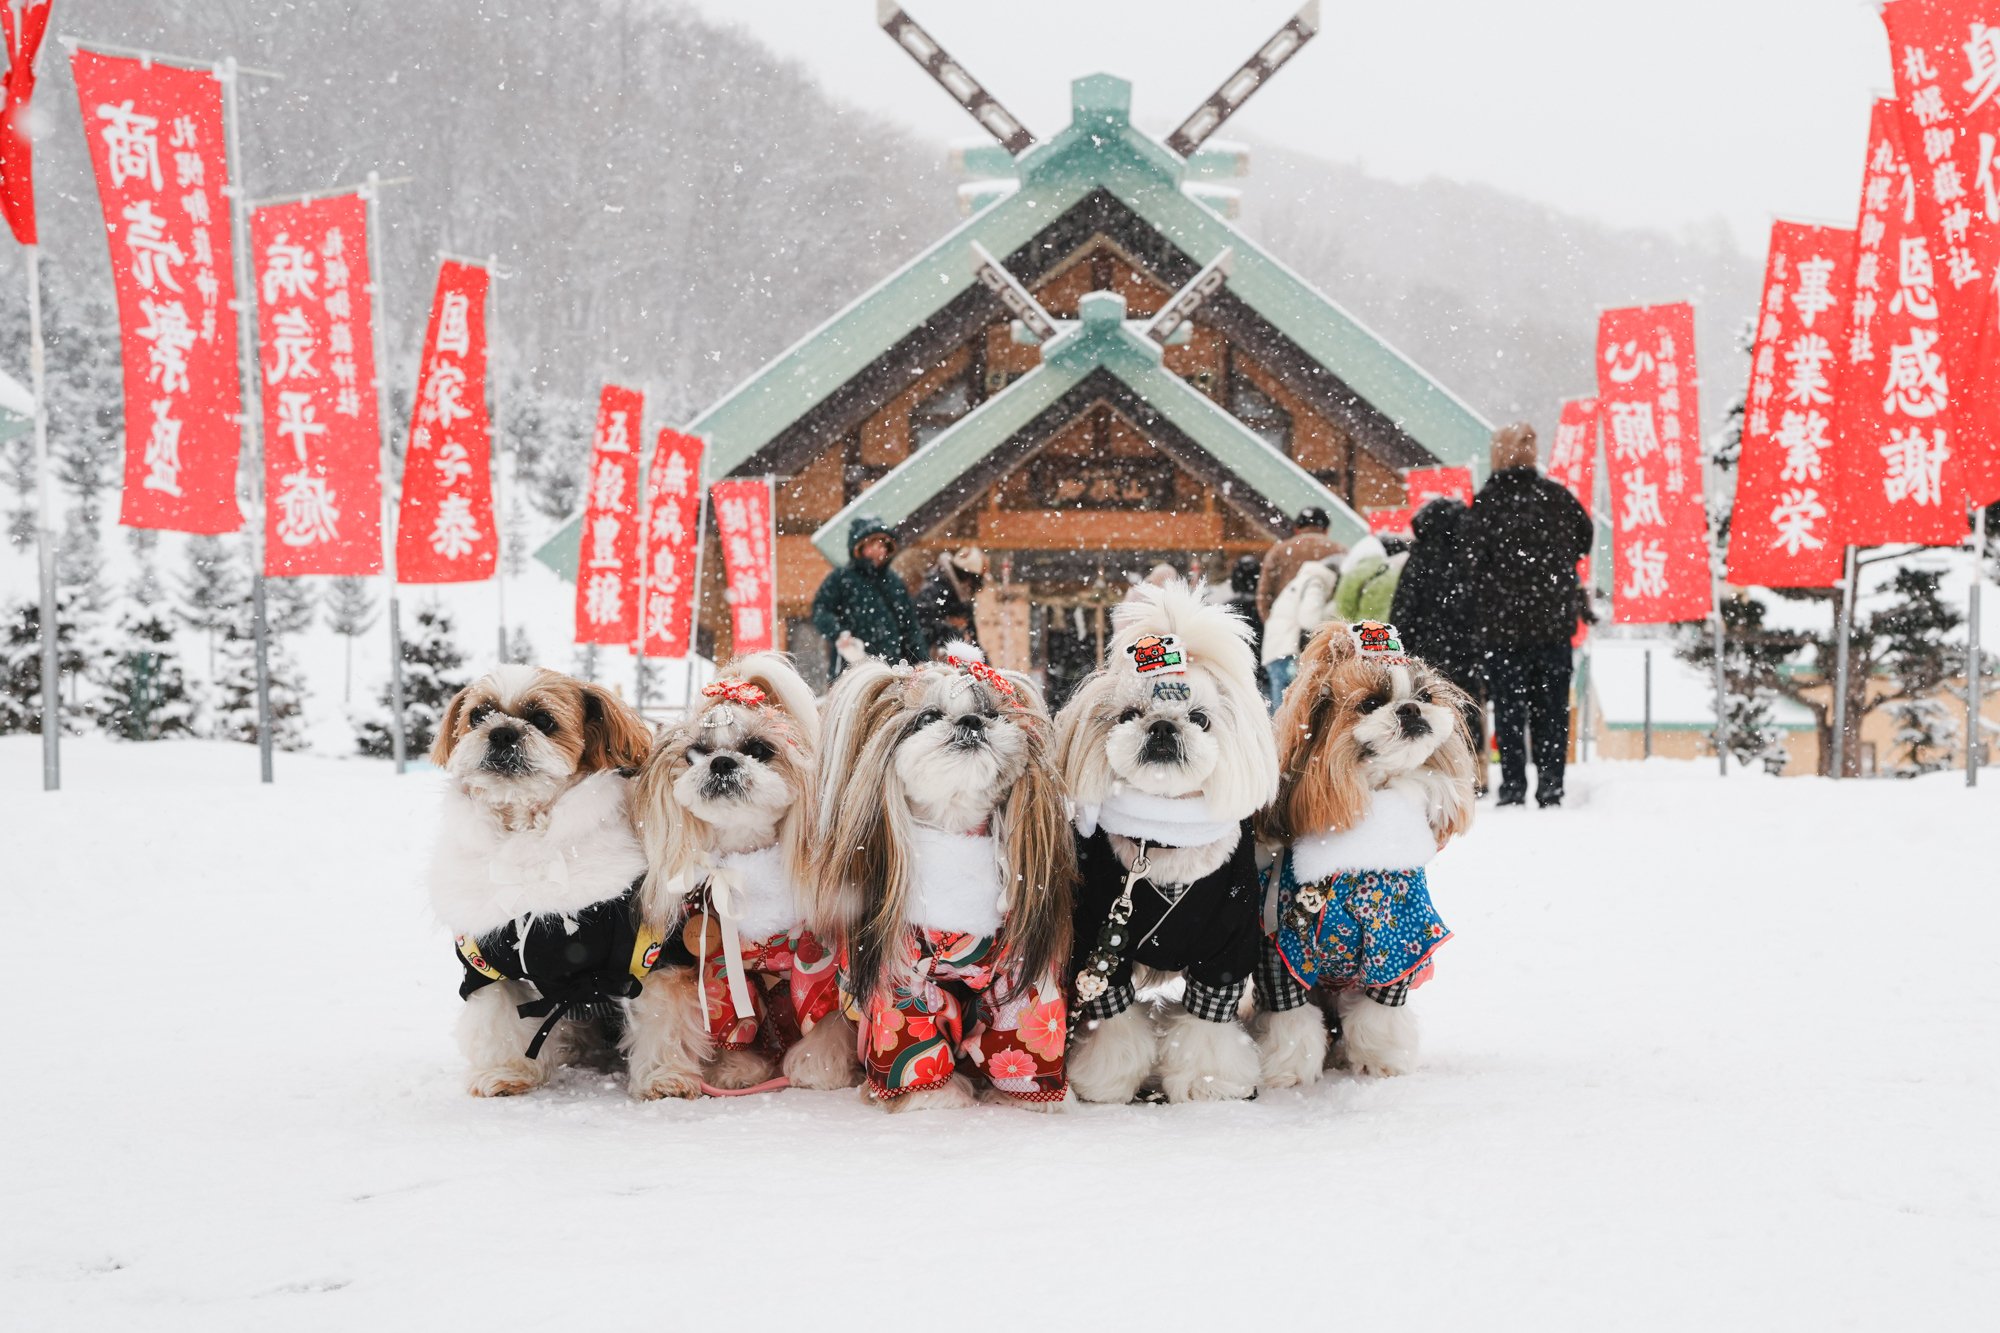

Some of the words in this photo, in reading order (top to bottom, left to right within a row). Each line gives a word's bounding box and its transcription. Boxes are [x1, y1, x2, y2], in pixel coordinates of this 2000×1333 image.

[1770, 253, 1837, 557] 事業繁栄
[645, 450, 690, 642] 無病息災
